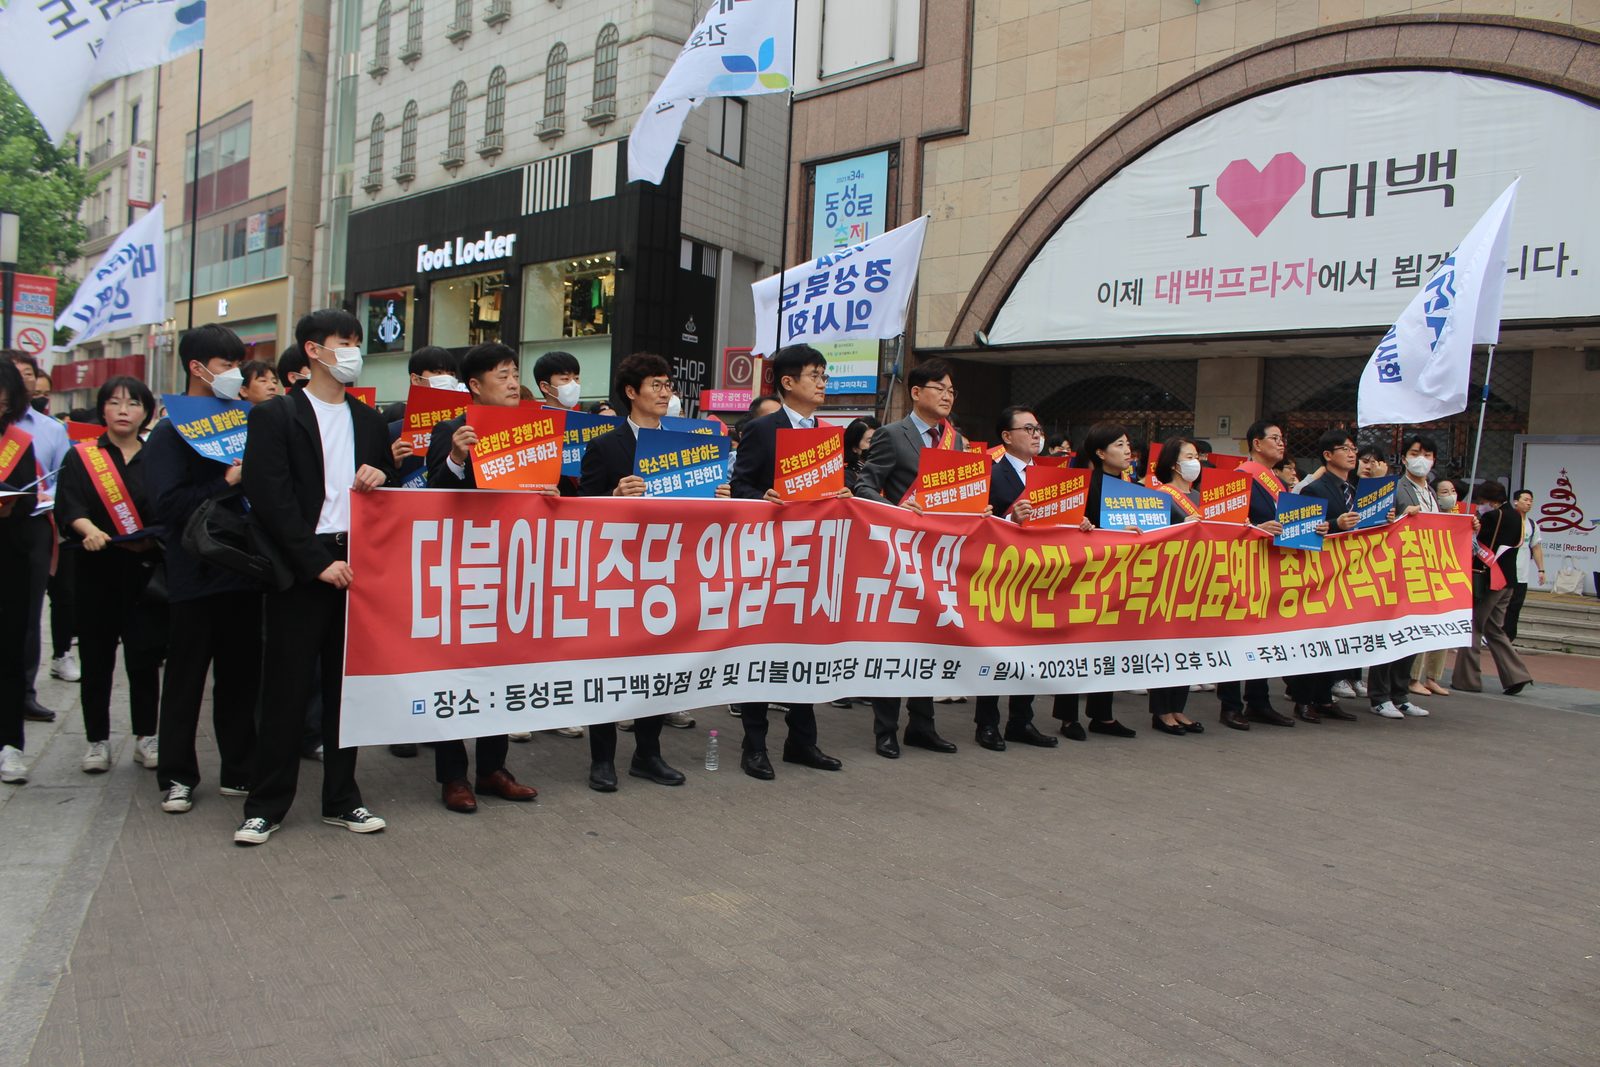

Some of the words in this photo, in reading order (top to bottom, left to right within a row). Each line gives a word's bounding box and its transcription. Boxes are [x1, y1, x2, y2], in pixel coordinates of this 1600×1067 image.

[1311, 148, 1458, 220] 대백
[825, 183, 873, 229] 동성로
[416, 242, 453, 273] Foot
[455, 230, 517, 266] Locker
[1097, 277, 1144, 308] 이제
[1154, 256, 1378, 306] 대백프라자에서
[672, 356, 706, 382] SHOP
[474, 430, 511, 458] 간호법안
[512, 418, 555, 445] 강행처리
[779, 447, 817, 475] 간호법안
[816, 433, 841, 460] 강행처리
[480, 454, 516, 481] 민주당은
[516, 441, 558, 467] 자폭하라
[638, 451, 679, 475] 약소직역
[680, 443, 720, 465] 말살하는
[784, 468, 820, 495] 민주당은
[820, 453, 844, 480] 자폭하라
[922, 468, 956, 489] 의료현장
[957, 460, 986, 481] 혼란초래
[643, 475, 683, 498] 간호협회
[684, 463, 724, 489] 규탄한다
[924, 487, 958, 509] 간호법안
[958, 479, 987, 500] 절대반대
[1029, 484, 1059, 505] 의료현장
[1059, 475, 1085, 496] 혼란초래
[1202, 485, 1225, 503] 무소불위
[1029, 502, 1059, 522] 간호법안
[1059, 492, 1085, 513] 절대반대
[1104, 496, 1135, 510] 약소직역
[1134, 496, 1165, 510] 말살하는
[1107, 512, 1138, 526] 간호협회
[1138, 512, 1168, 526] 규탄한다
[1278, 507, 1300, 525] 약소직역
[1300, 503, 1323, 519] 말살하는
[1562, 543, 1598, 554] [Re:Born]
[410, 517, 683, 645] 더불어민주당
[695, 518, 853, 632] 입법독재
[855, 522, 926, 625] 규탄
[932, 535, 967, 629] 및
[969, 542, 1074, 629] 400만
[1067, 538, 1271, 626] 보건복지의료연대
[1278, 531, 1397, 619] 총선기획단
[1398, 525, 1473, 604] 출범식
[1257, 644, 1289, 664] 주최
[1300, 640, 1333, 660] 13개
[1336, 633, 1388, 655] 대구경북
[1388, 618, 1473, 646] 보건복지의료
[993, 660, 1026, 681] 일시
[1038, 657, 1089, 679] 2023년
[1093, 655, 1116, 676] 5월
[1121, 651, 1170, 675] 3일(수)
[1175, 651, 1203, 671] 오후
[1207, 650, 1232, 668] 5시
[433, 688, 481, 720] 장소
[505, 681, 575, 712] 동성로
[583, 669, 693, 704] 대구백화점
[697, 666, 718, 690] 앞
[723, 662, 740, 686] 및
[748, 657, 859, 685] 더불어민주당
[864, 657, 937, 681] 대구시당
[940, 659, 962, 681] 앞
